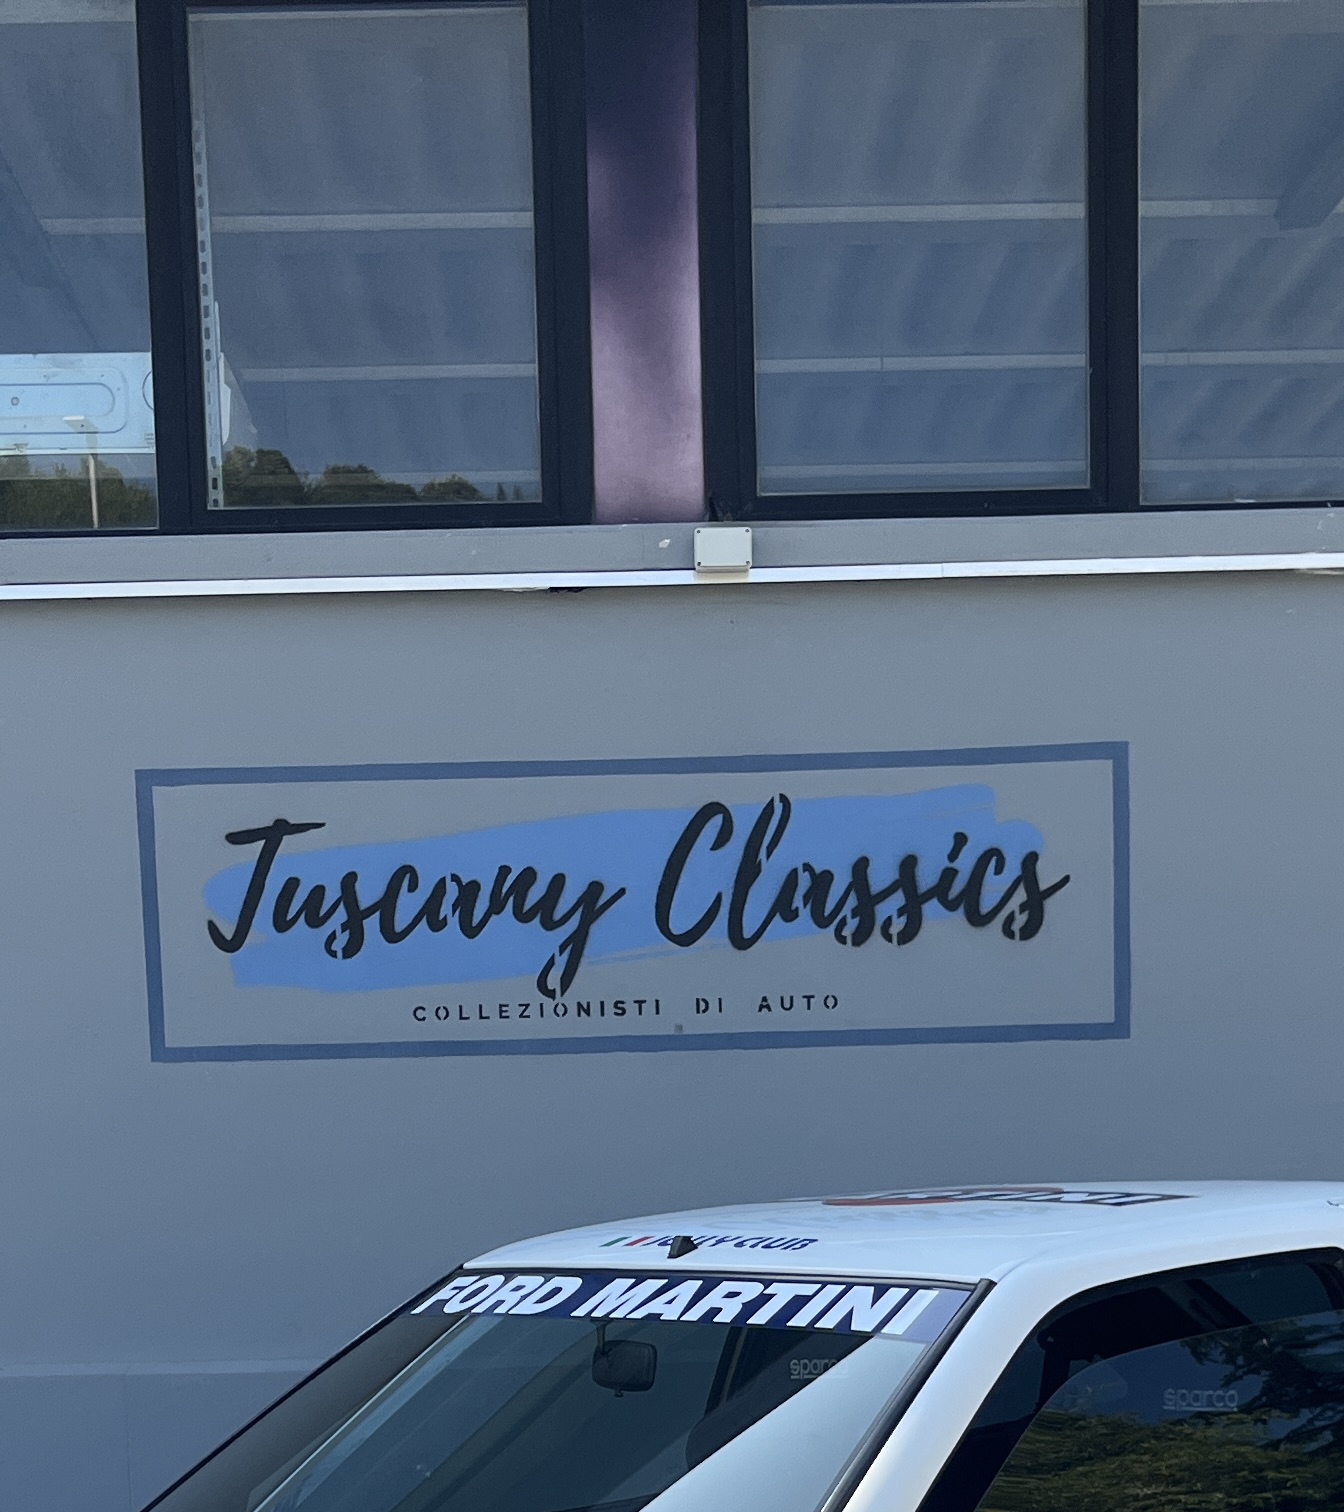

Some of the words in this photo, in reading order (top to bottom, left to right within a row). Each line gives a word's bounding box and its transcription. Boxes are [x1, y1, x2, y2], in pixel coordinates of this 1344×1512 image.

[207, 818, 626, 999] Tuscany
[655, 793, 1071, 952] Classics
[412, 1000, 662, 1023] COLLEZIONISTI
[695, 996, 724, 1016] DI
[758, 993, 840, 1015] AUTO
[412, 1275, 585, 1317] FORD
[570, 1277, 939, 1336] MARTINI
[1162, 1388, 1239, 1412] sparco
